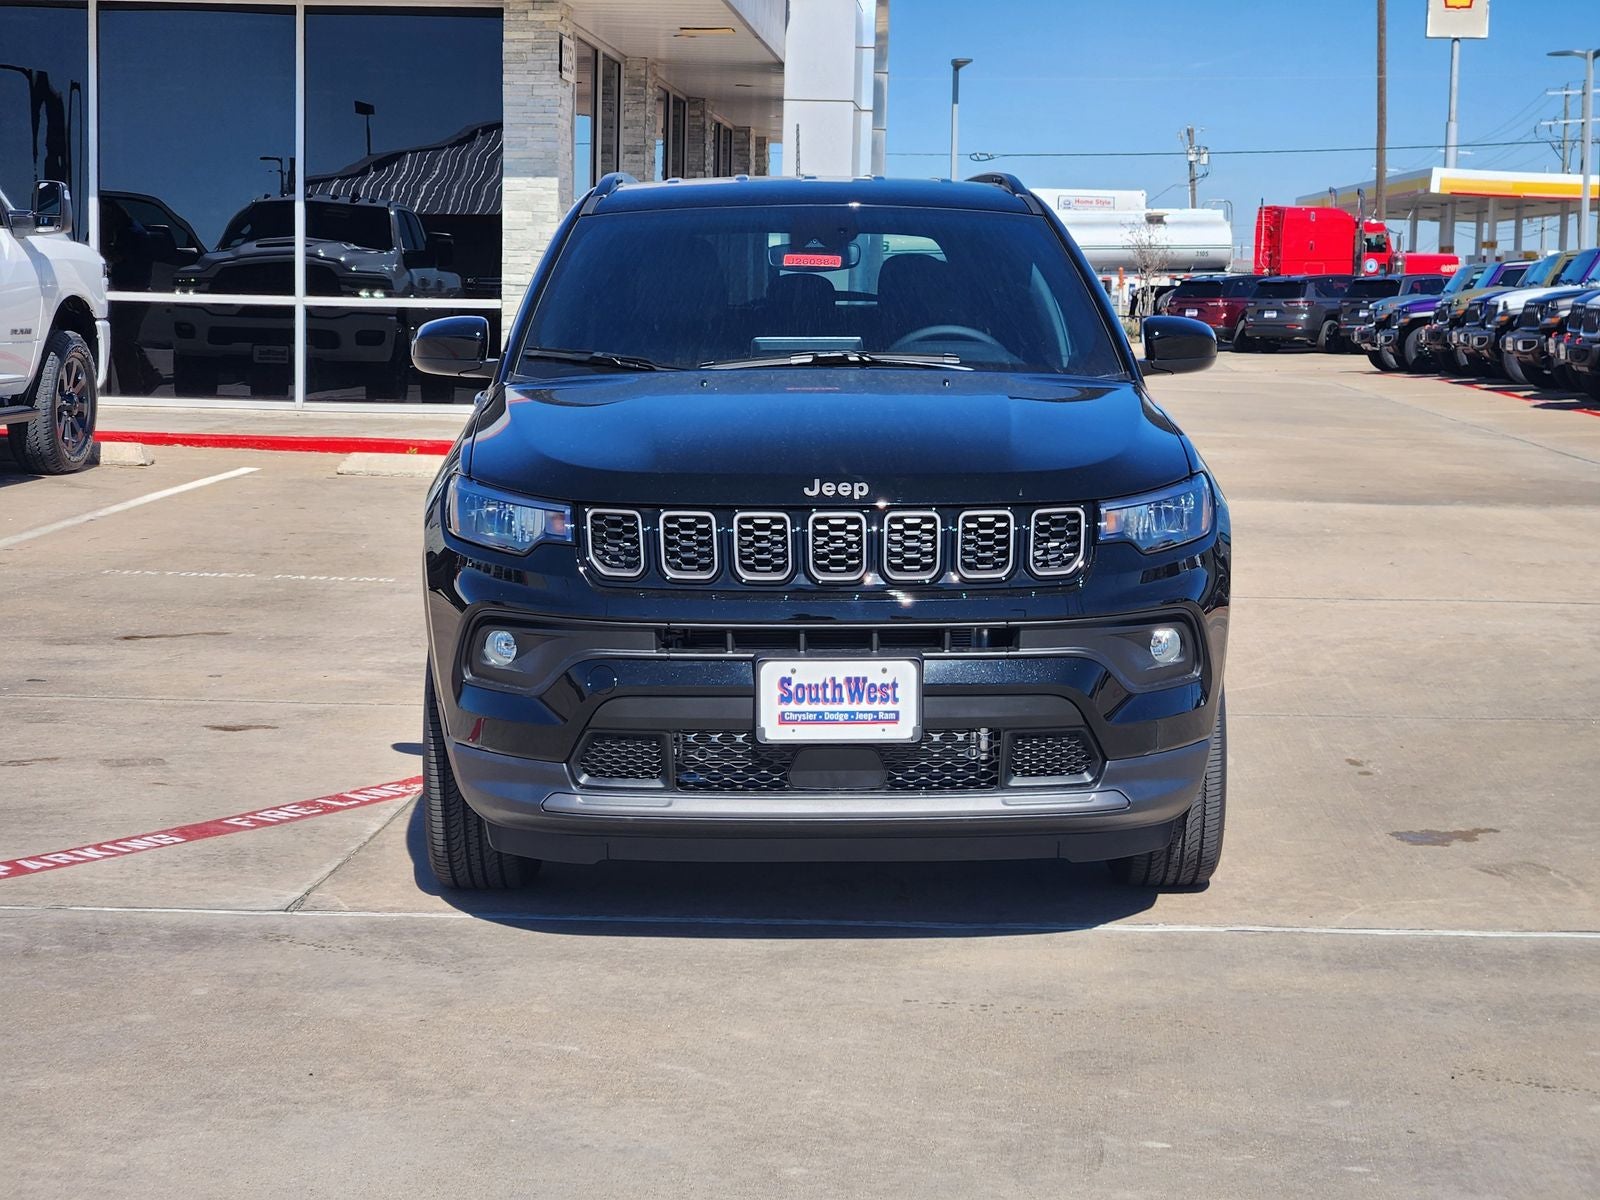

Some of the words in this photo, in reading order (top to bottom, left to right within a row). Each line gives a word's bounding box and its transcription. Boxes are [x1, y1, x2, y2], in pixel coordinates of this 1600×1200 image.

[803, 478, 869, 499] Jeep
[784, 711, 817, 722] Chrysler
[824, 711, 849, 721] Dodge
[855, 711, 874, 722] Jeep
[879, 711, 896, 720] Ram
[223, 804, 323, 827] FIRE
